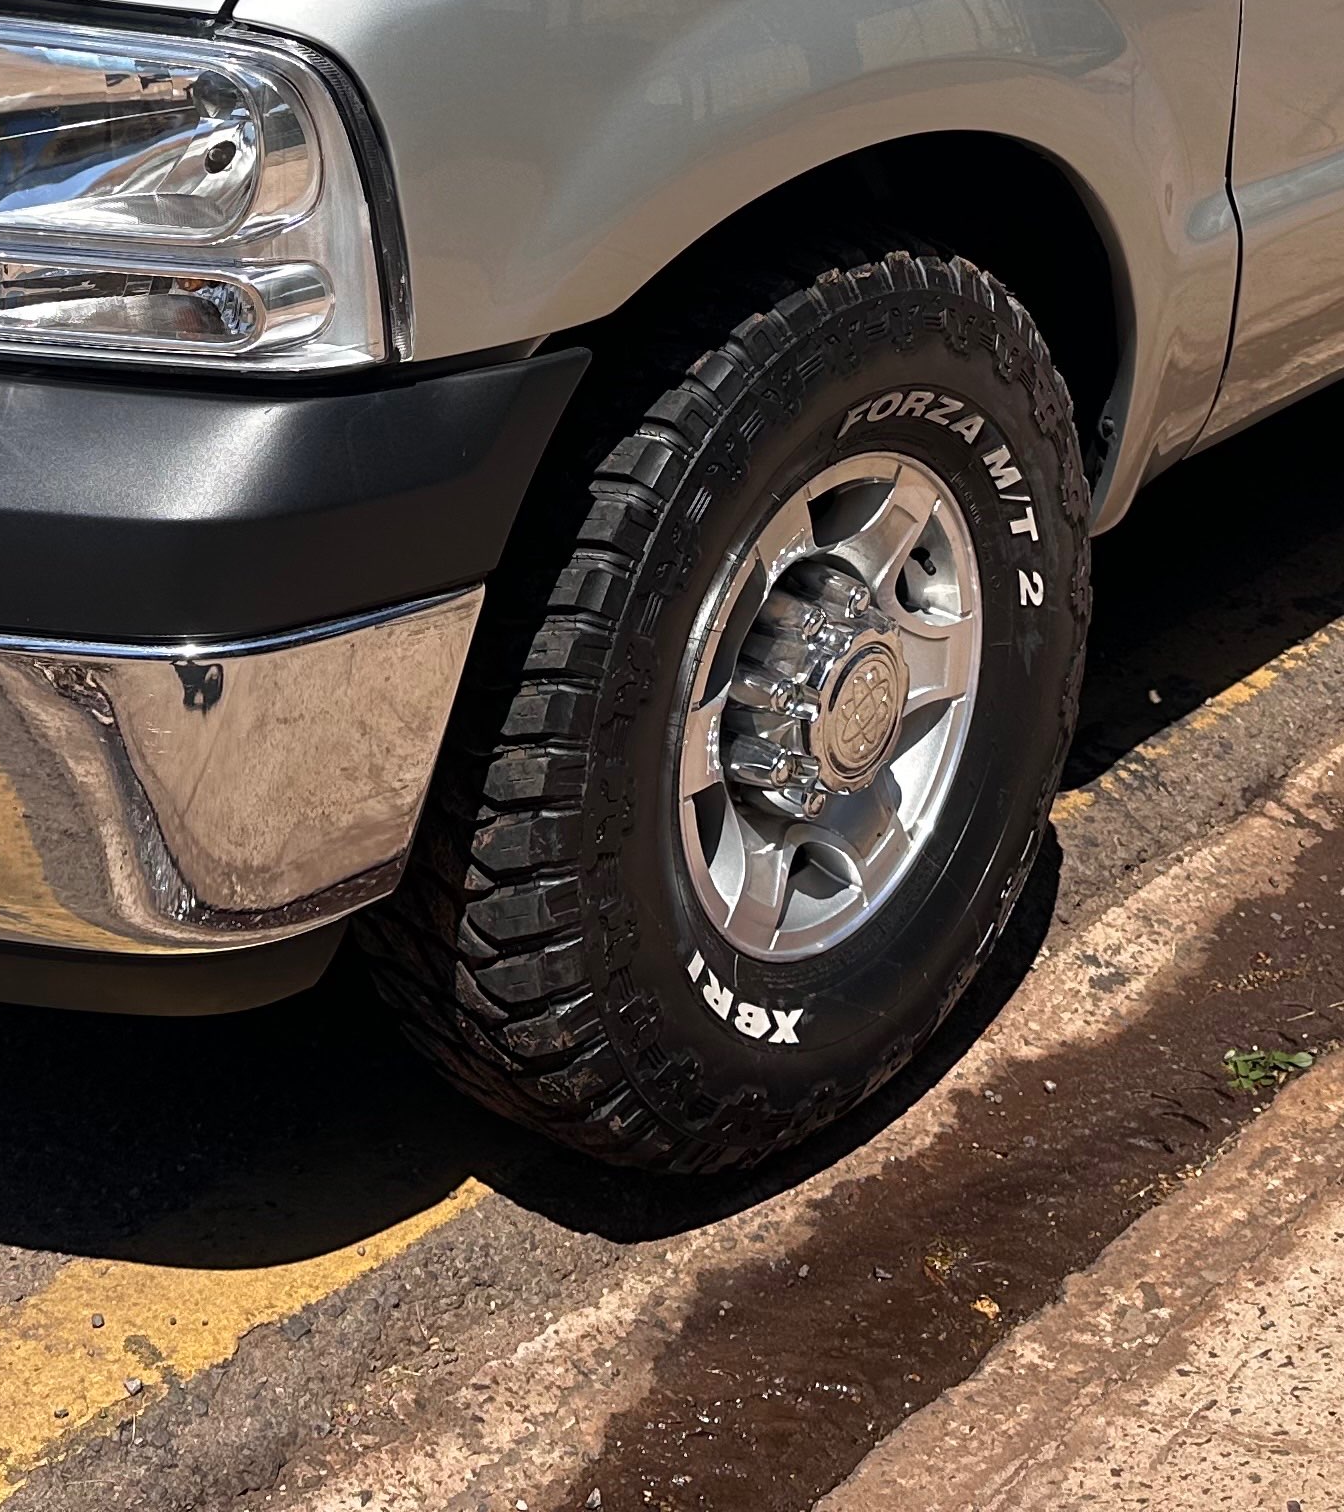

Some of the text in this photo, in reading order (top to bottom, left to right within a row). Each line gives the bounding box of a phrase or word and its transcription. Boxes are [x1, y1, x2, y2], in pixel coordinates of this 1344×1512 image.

[836, 390, 985, 445] FORZA
[981, 444, 1039, 542] M/T
[1016, 568, 1044, 606] 2
[687, 950, 804, 1044] XBRI
